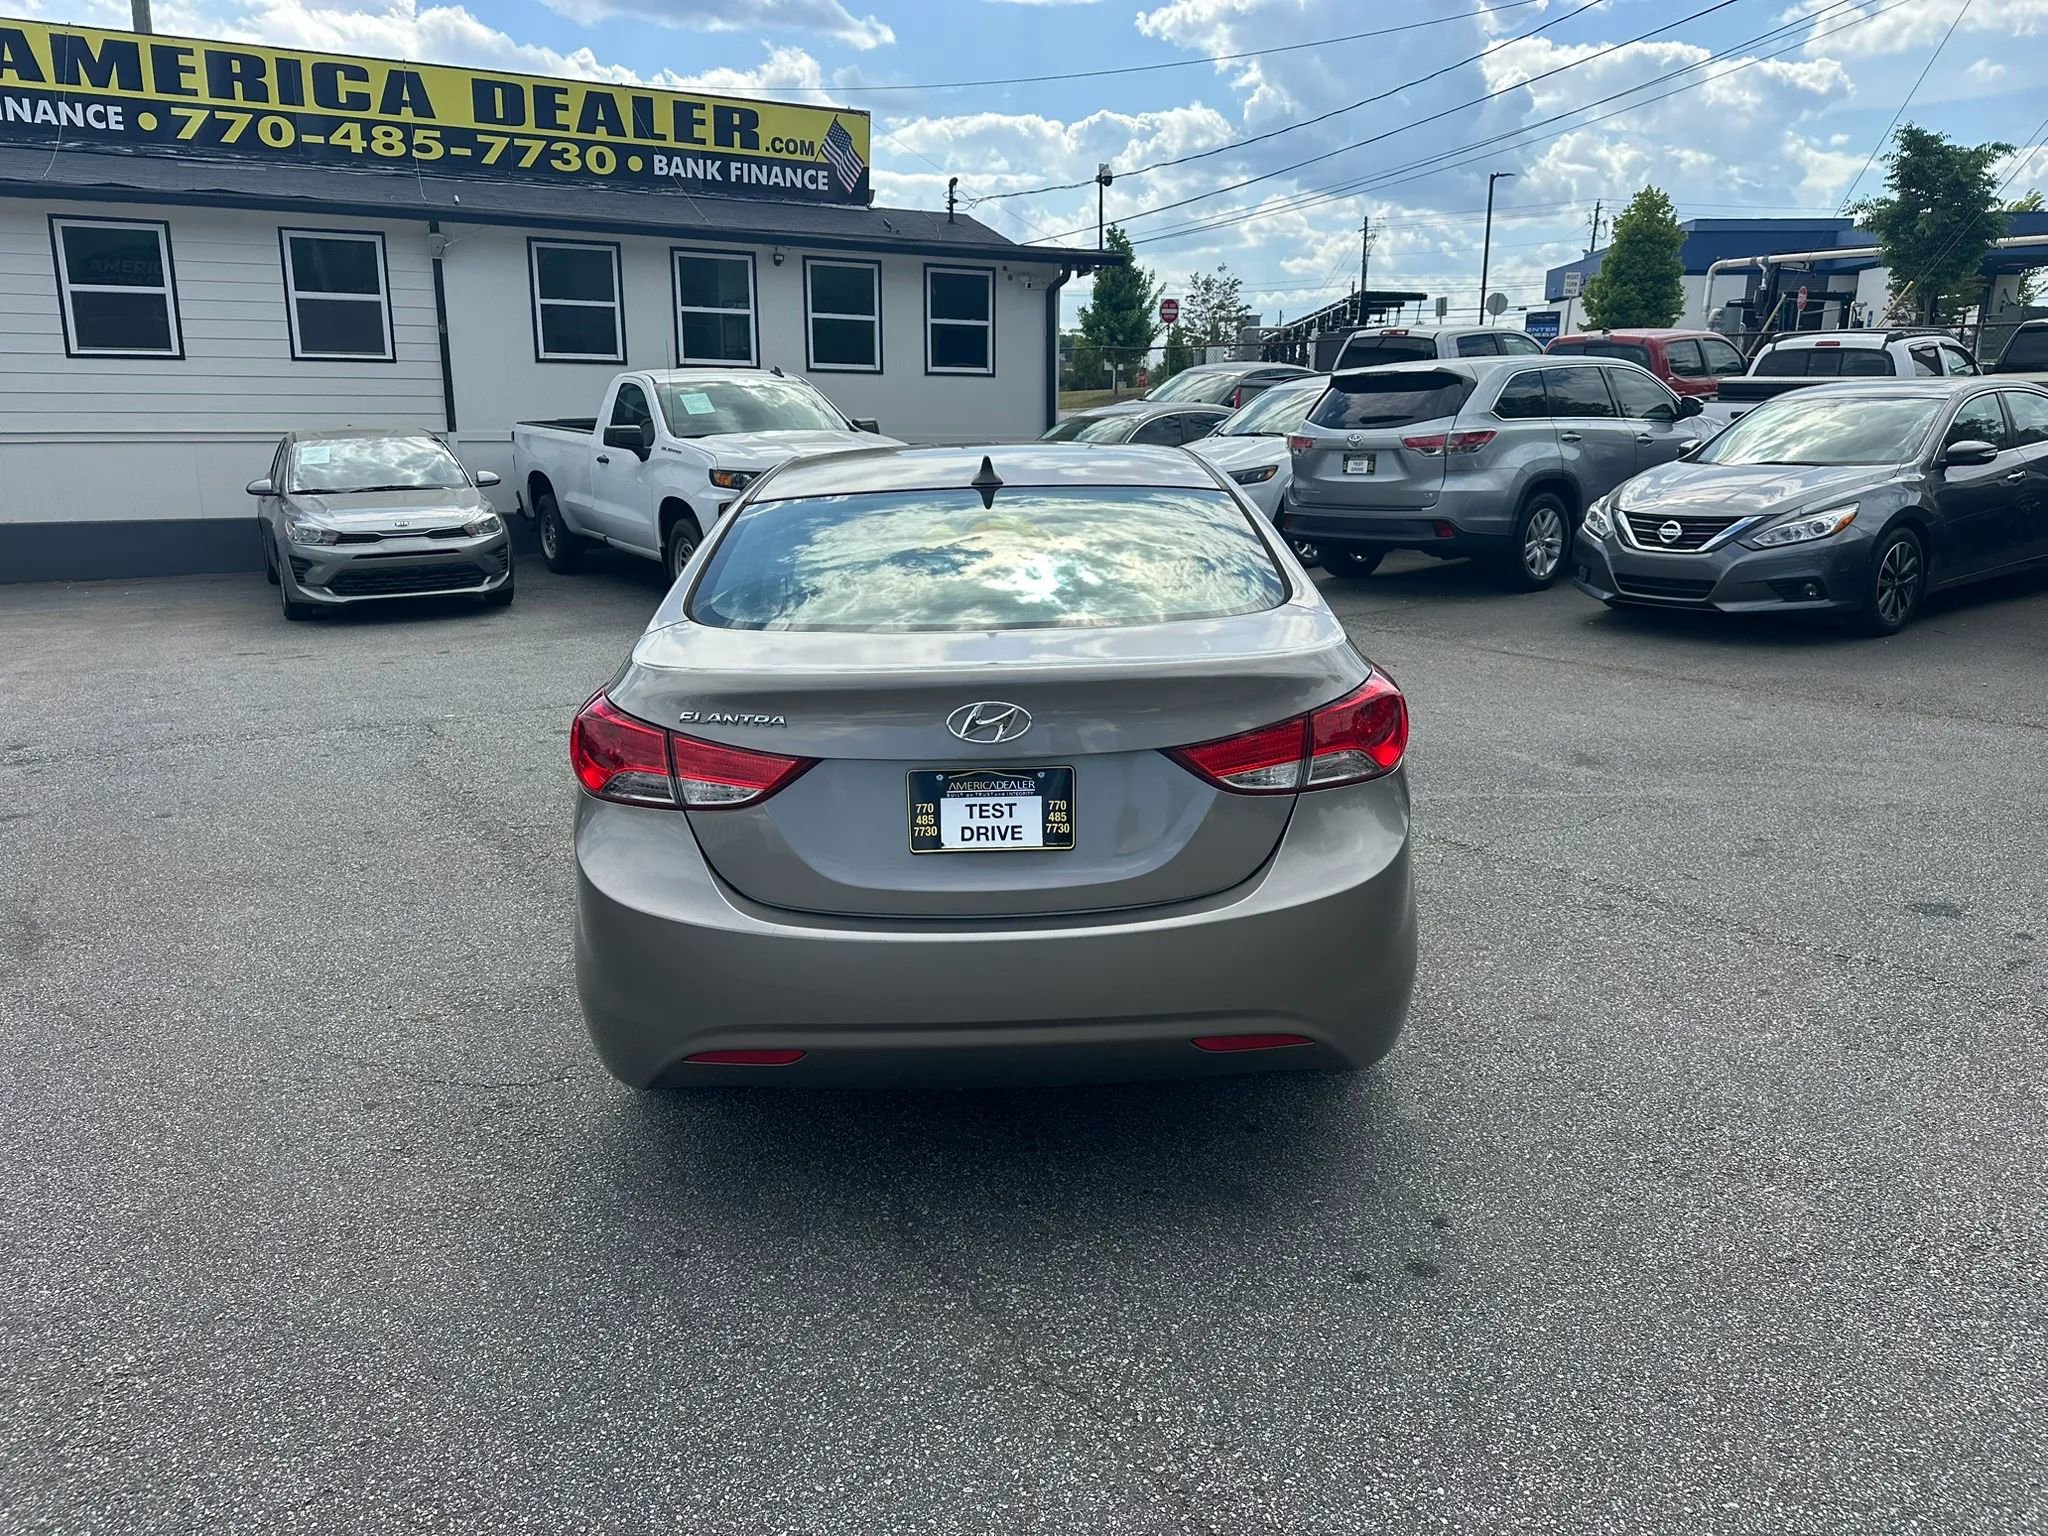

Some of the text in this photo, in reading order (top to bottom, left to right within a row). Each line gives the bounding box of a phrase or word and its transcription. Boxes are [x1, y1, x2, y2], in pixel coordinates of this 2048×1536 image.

[0, 28, 815, 157] AMERICA DEALER .COM
[0, 96, 829, 191] NANCE 770-485-7730 BANK FINANCE
[680, 711, 787, 727] ELANTRA
[948, 780, 1036, 790] AMERICADEALER
[915, 803, 934, 813] 770
[965, 802, 1017, 819] TEST
[1048, 800, 1067, 810] 770
[915, 815, 935, 825] 485
[1048, 811, 1067, 822] 485
[913, 826, 938, 837] 7730
[960, 825, 1023, 841] DRIVE
[1045, 823, 1070, 834] 7730
